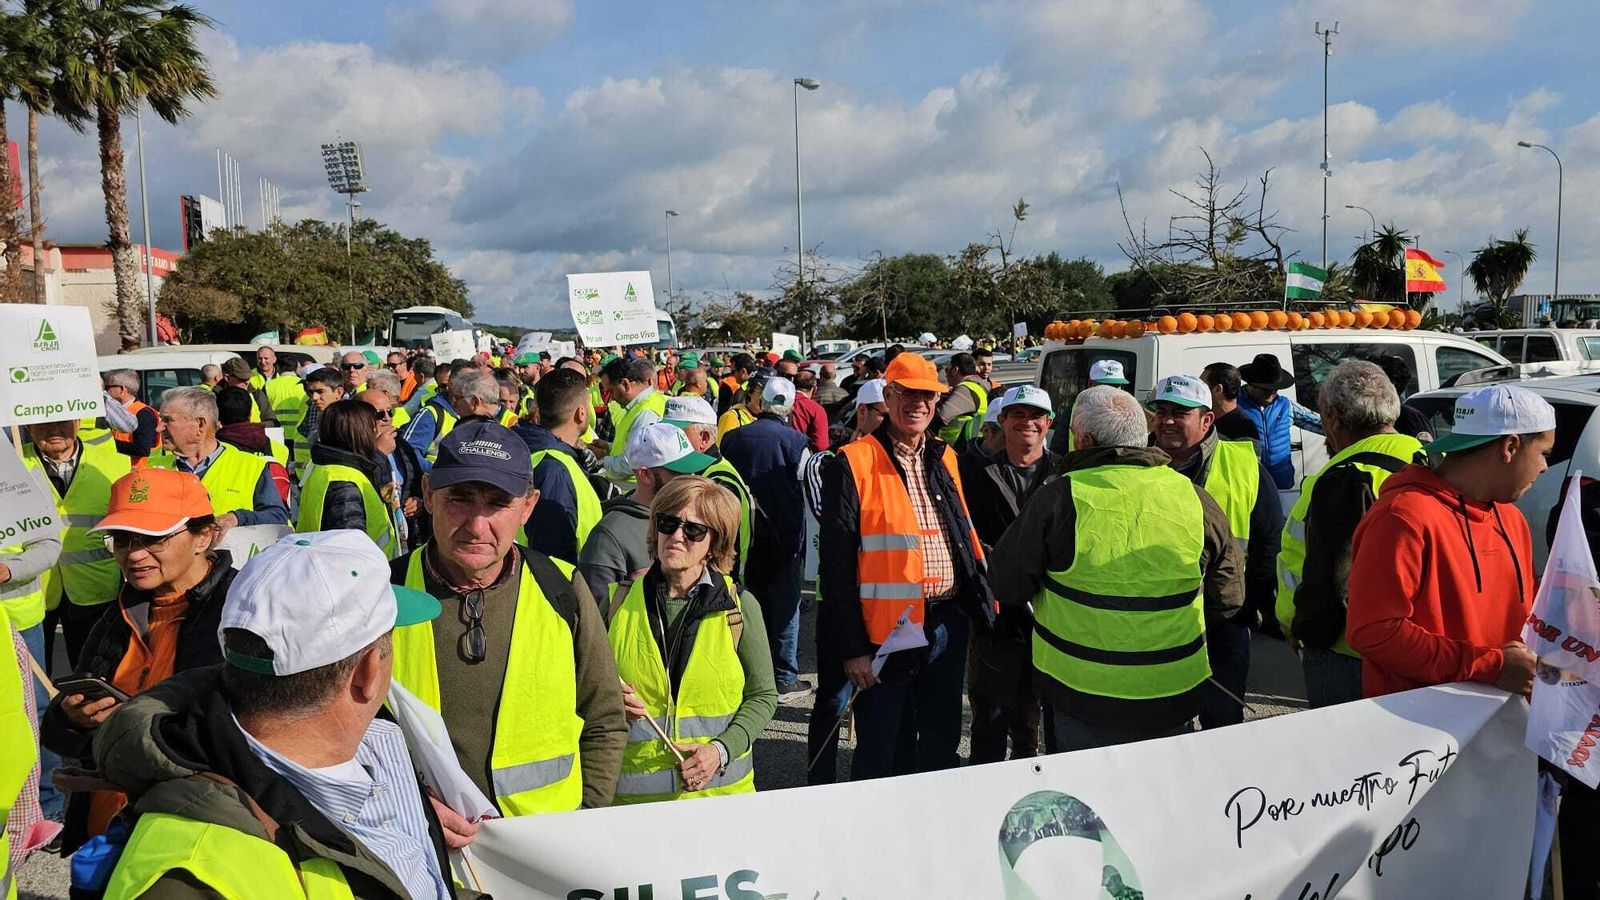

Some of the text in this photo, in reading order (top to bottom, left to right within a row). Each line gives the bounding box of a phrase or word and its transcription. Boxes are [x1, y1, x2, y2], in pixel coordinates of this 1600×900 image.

[615, 330, 656, 342] Campo Vivo
[14, 399, 97, 417] Campo Vivo
[460, 447, 507, 460] CHALLENGE
[129, 494, 148, 502] UPA
[16, 517, 52, 532] Vivo
[1311, 772, 1398, 811] nuestro
